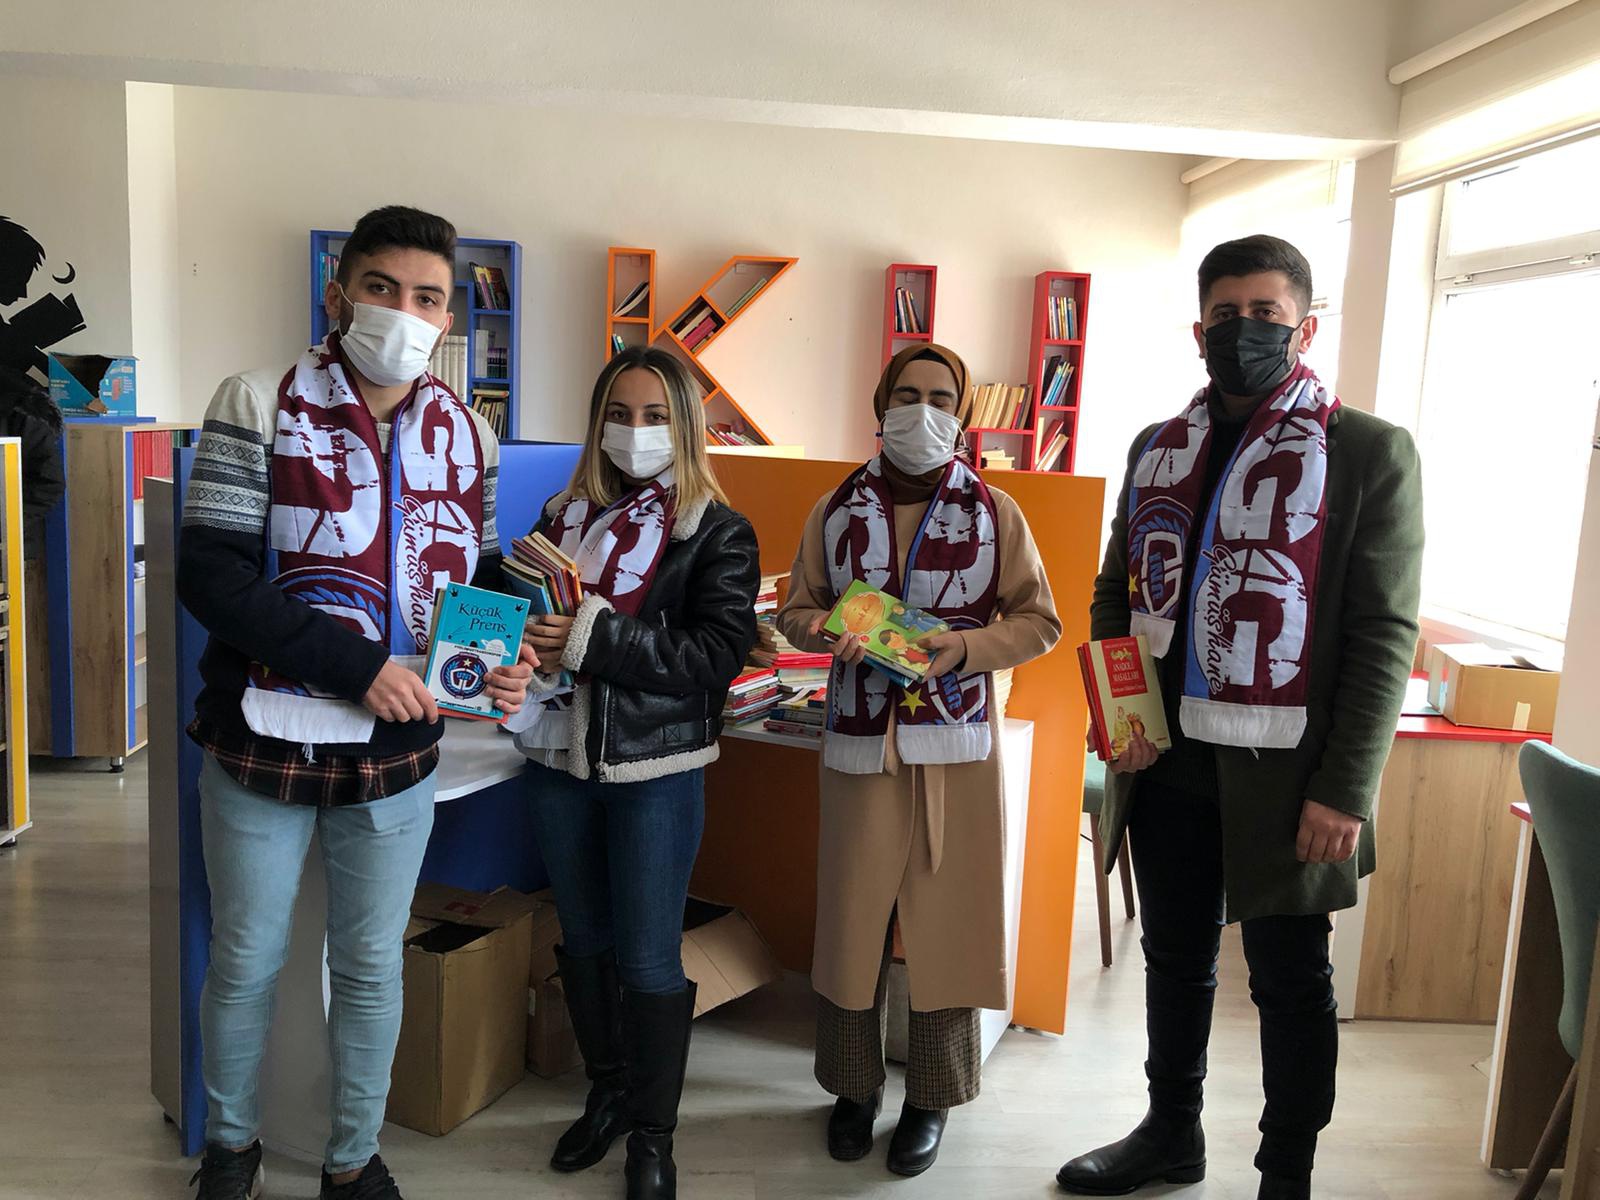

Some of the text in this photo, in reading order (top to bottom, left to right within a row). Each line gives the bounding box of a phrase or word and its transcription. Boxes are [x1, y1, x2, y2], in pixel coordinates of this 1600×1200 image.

[393, 495, 433, 650] Gümüşhane
[458, 602, 503, 620] Küçük
[470, 617, 507, 633] Prens
[1202, 544, 1233, 694] Gümüşhane
